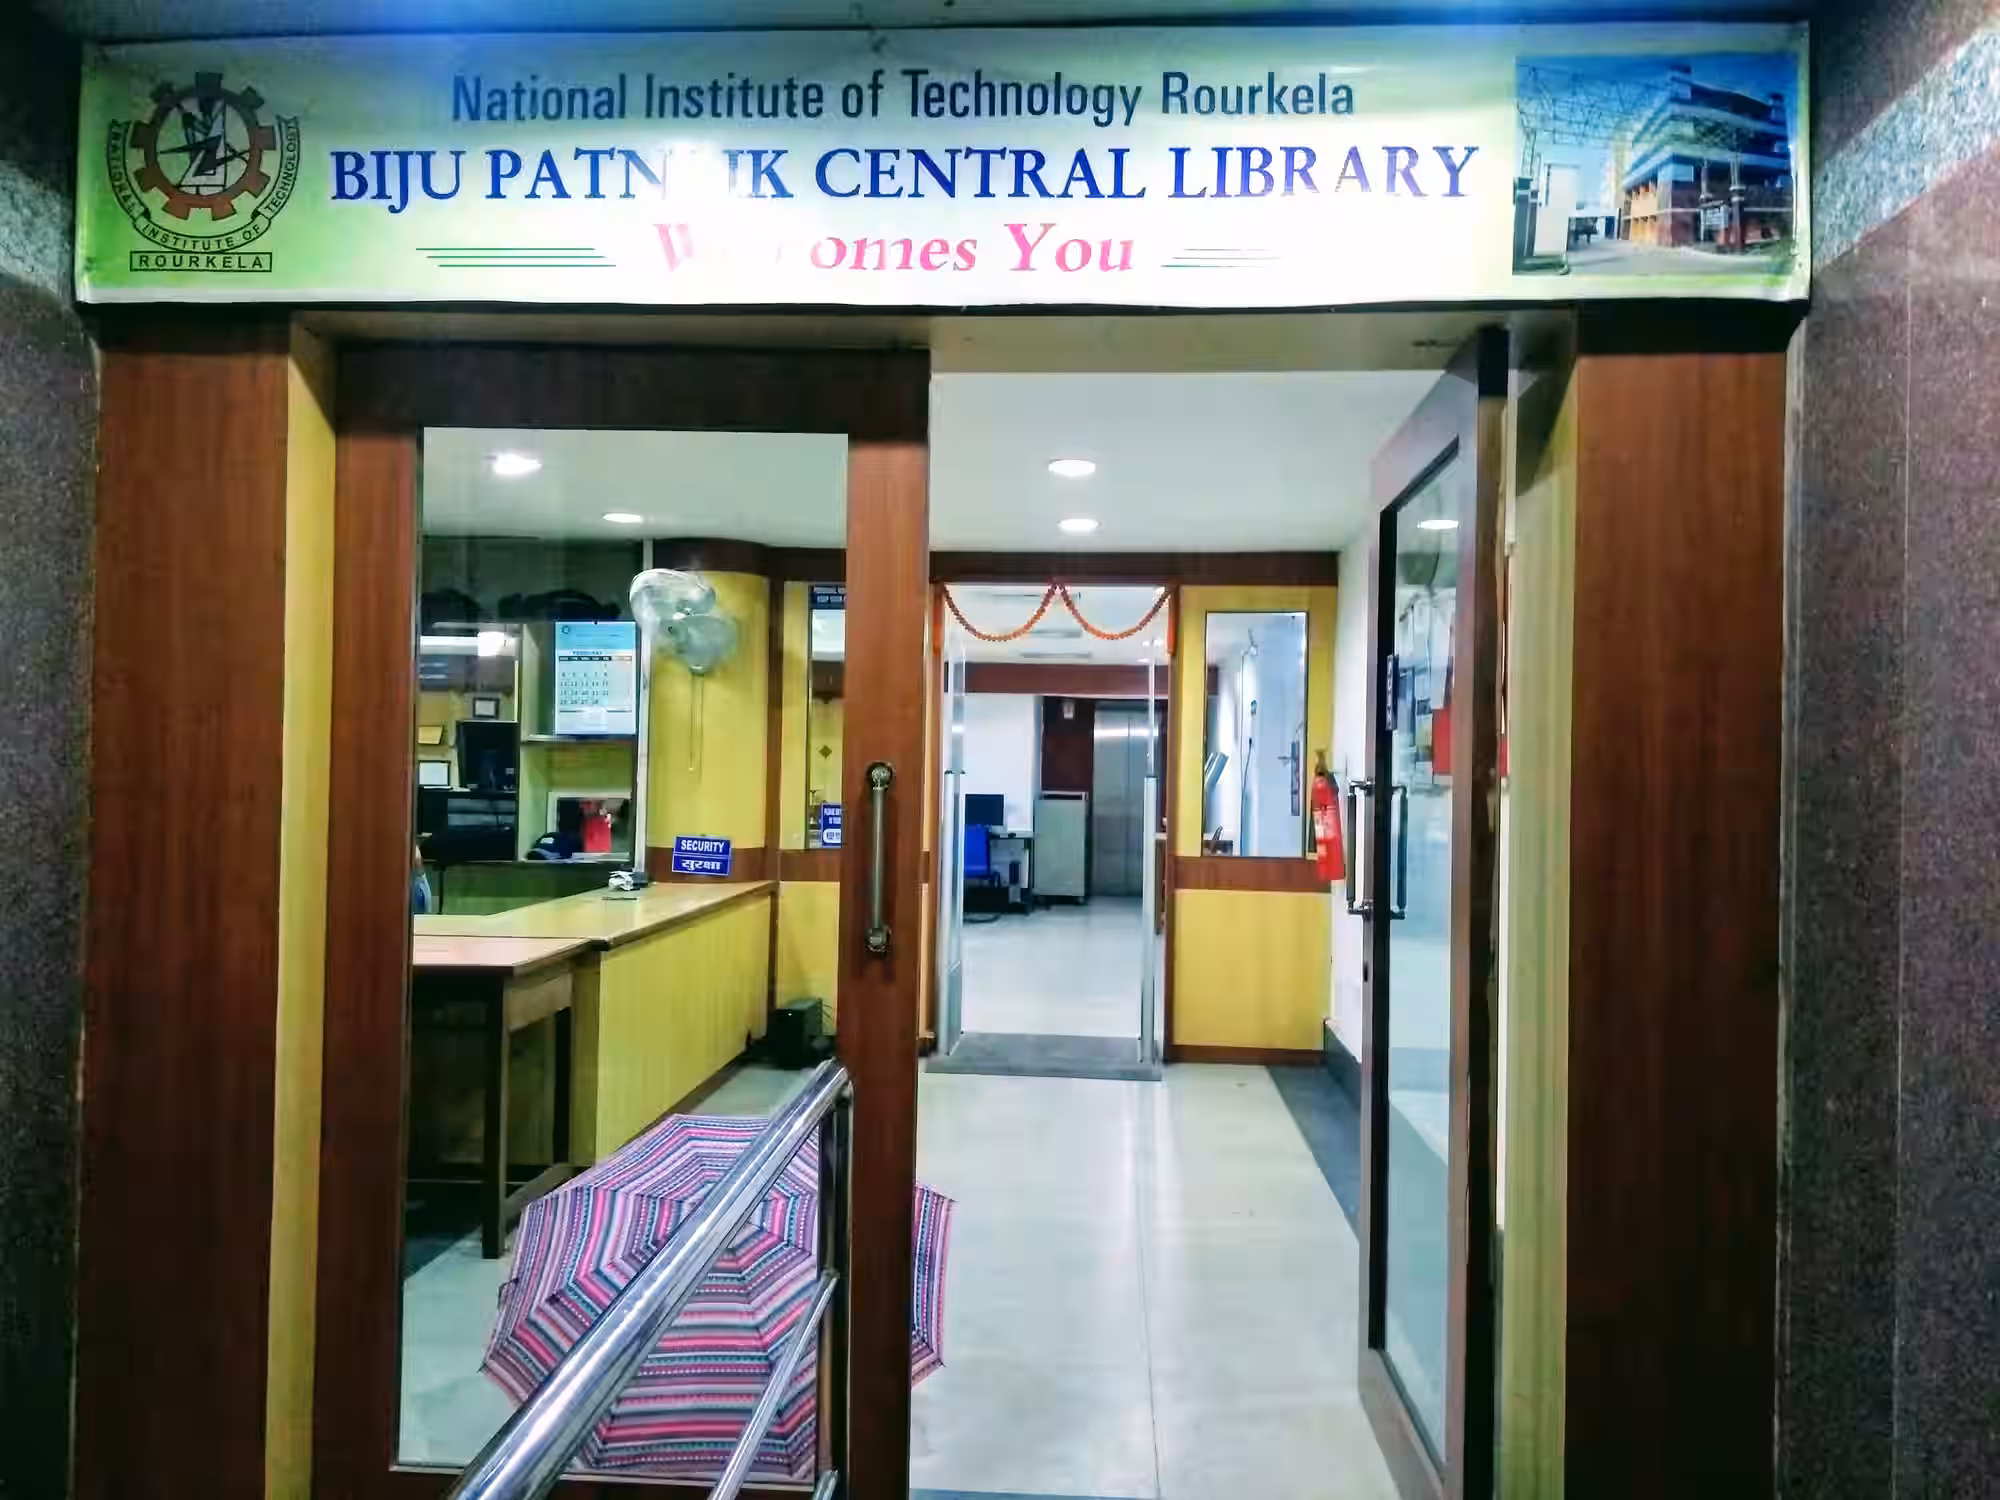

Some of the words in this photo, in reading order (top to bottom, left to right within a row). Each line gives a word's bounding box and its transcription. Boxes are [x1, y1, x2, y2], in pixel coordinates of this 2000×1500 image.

[453, 73, 627, 121] National
[645, 72, 824, 119] Institute
[841, 69, 885, 118] of
[901, 68, 1142, 128] Technology
[1161, 71, 1354, 116] Rourkela
[330, 150, 467, 214] BIJU
[485, 147, 794, 200] PATNIK
[814, 146, 1147, 199] CENTRAL
[1167, 145, 1480, 198] LIBRARY
[141, 221, 235, 250] INSTITUTE
[242, 224, 261, 240] OF
[653, 222, 977, 273] Womes
[1003, 222, 1134, 272] You
[139, 255, 263, 269] ROURKELA
[681, 839, 725, 853] SECURITY
